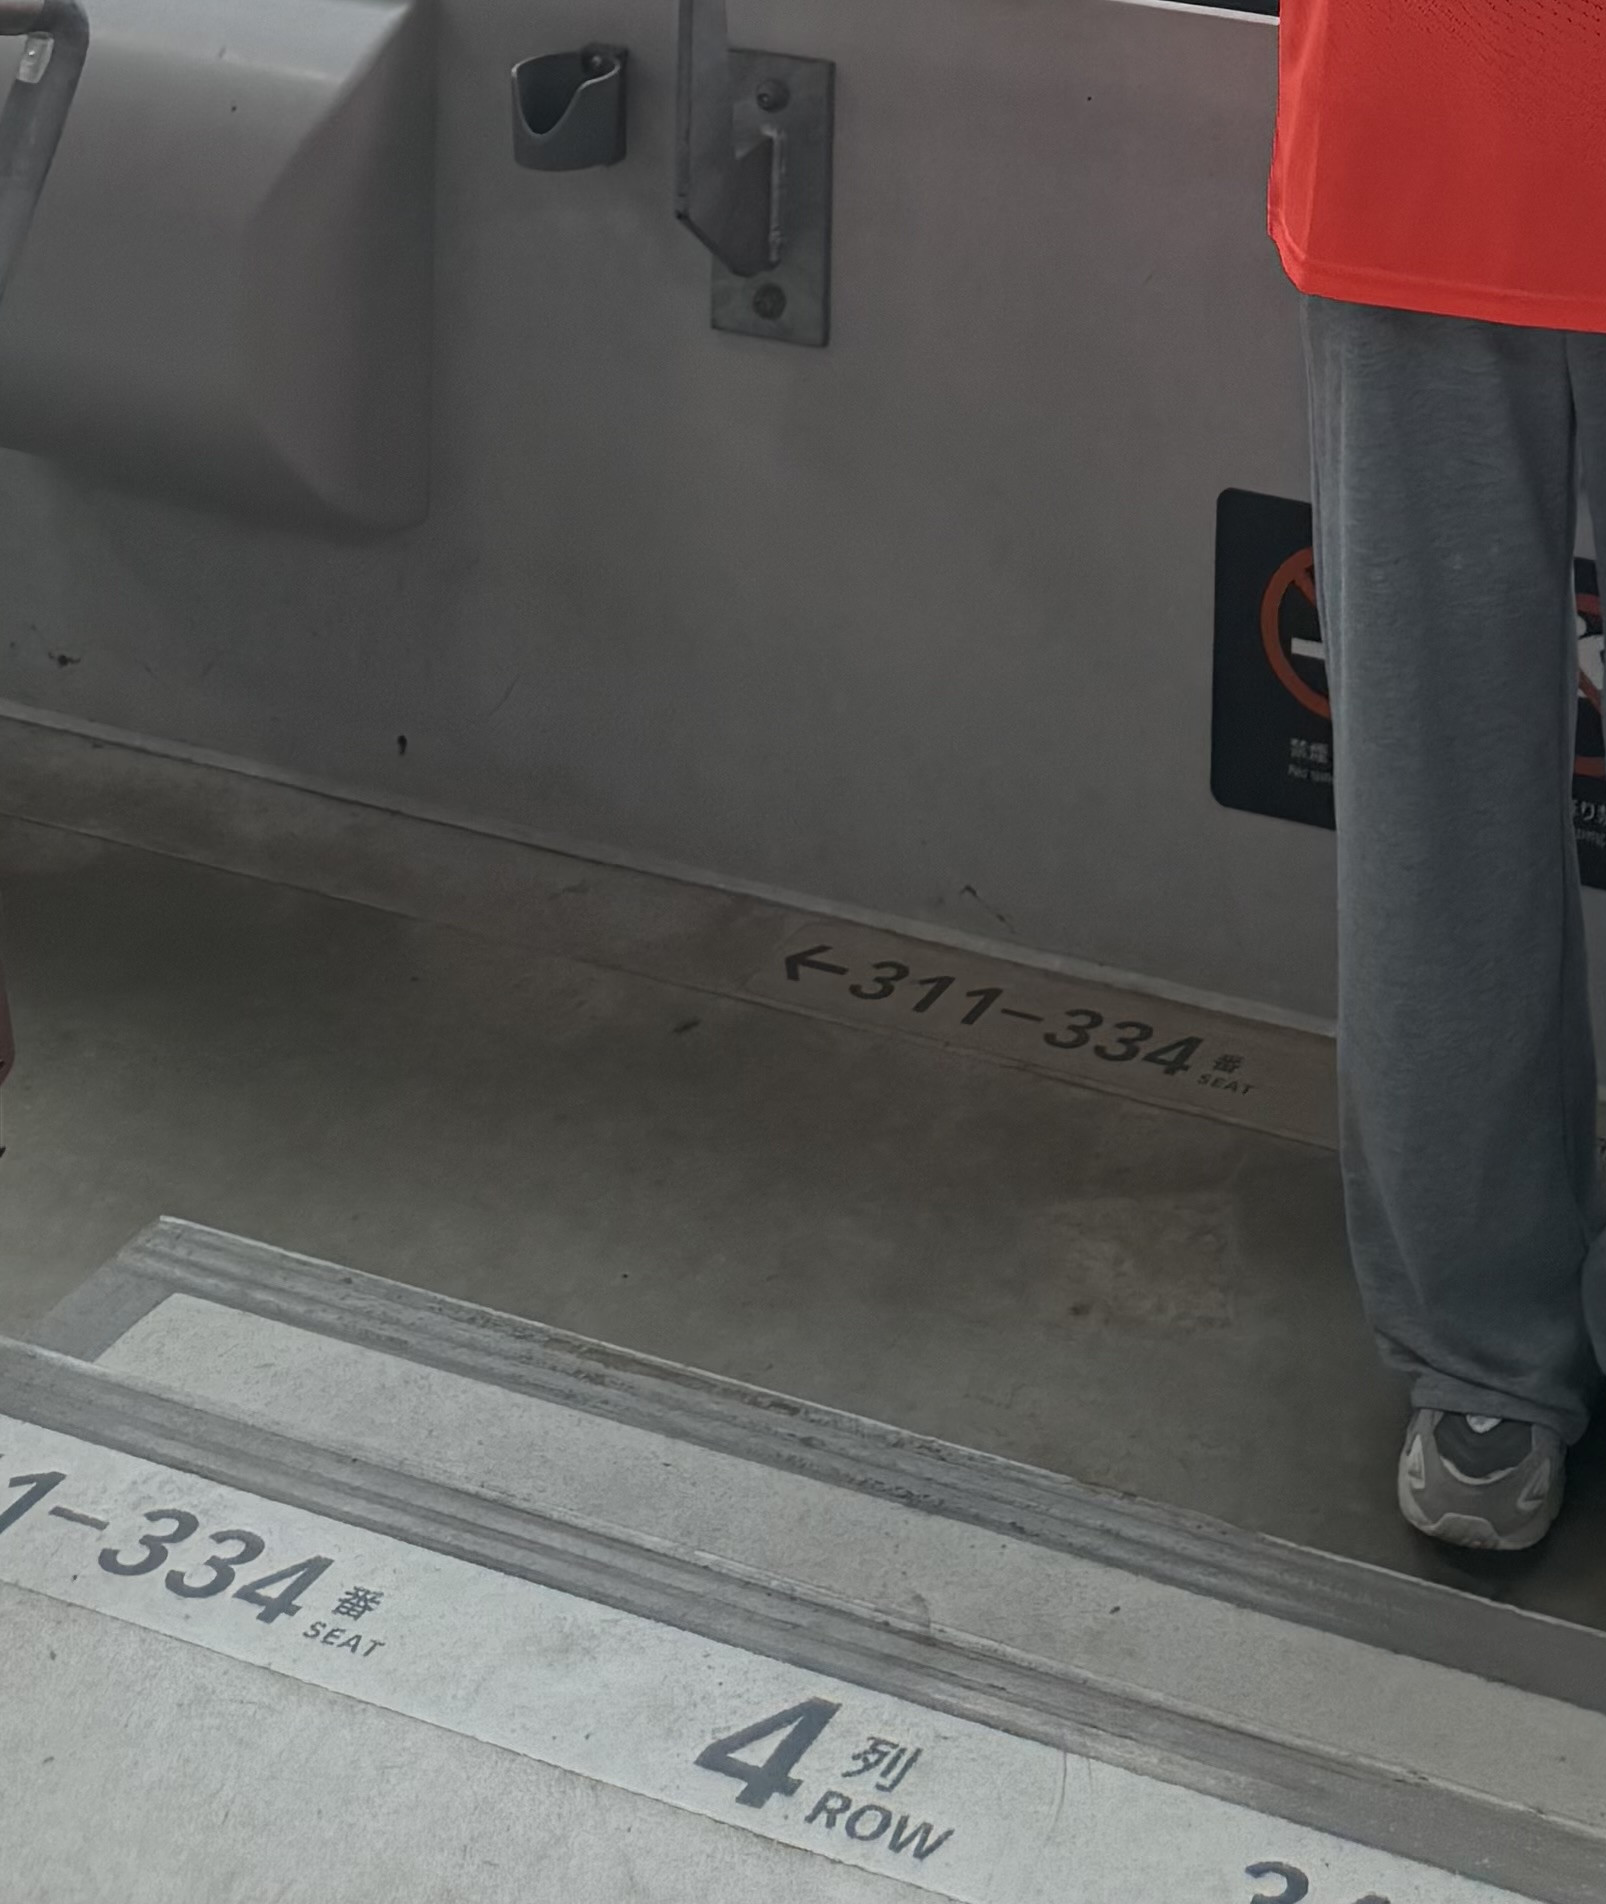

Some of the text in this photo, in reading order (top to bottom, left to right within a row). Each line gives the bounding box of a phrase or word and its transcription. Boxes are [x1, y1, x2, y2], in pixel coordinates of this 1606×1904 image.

[847, 960, 1205, 1076] 311-334
[1197, 1073, 1255, 1097] SEAT
[0, 1470, 386, 1625] 1-334 番
[302, 1619, 387, 1659] SEAT
[692, 1695, 921, 1809] 4 列
[804, 1788, 956, 1862] ROW
